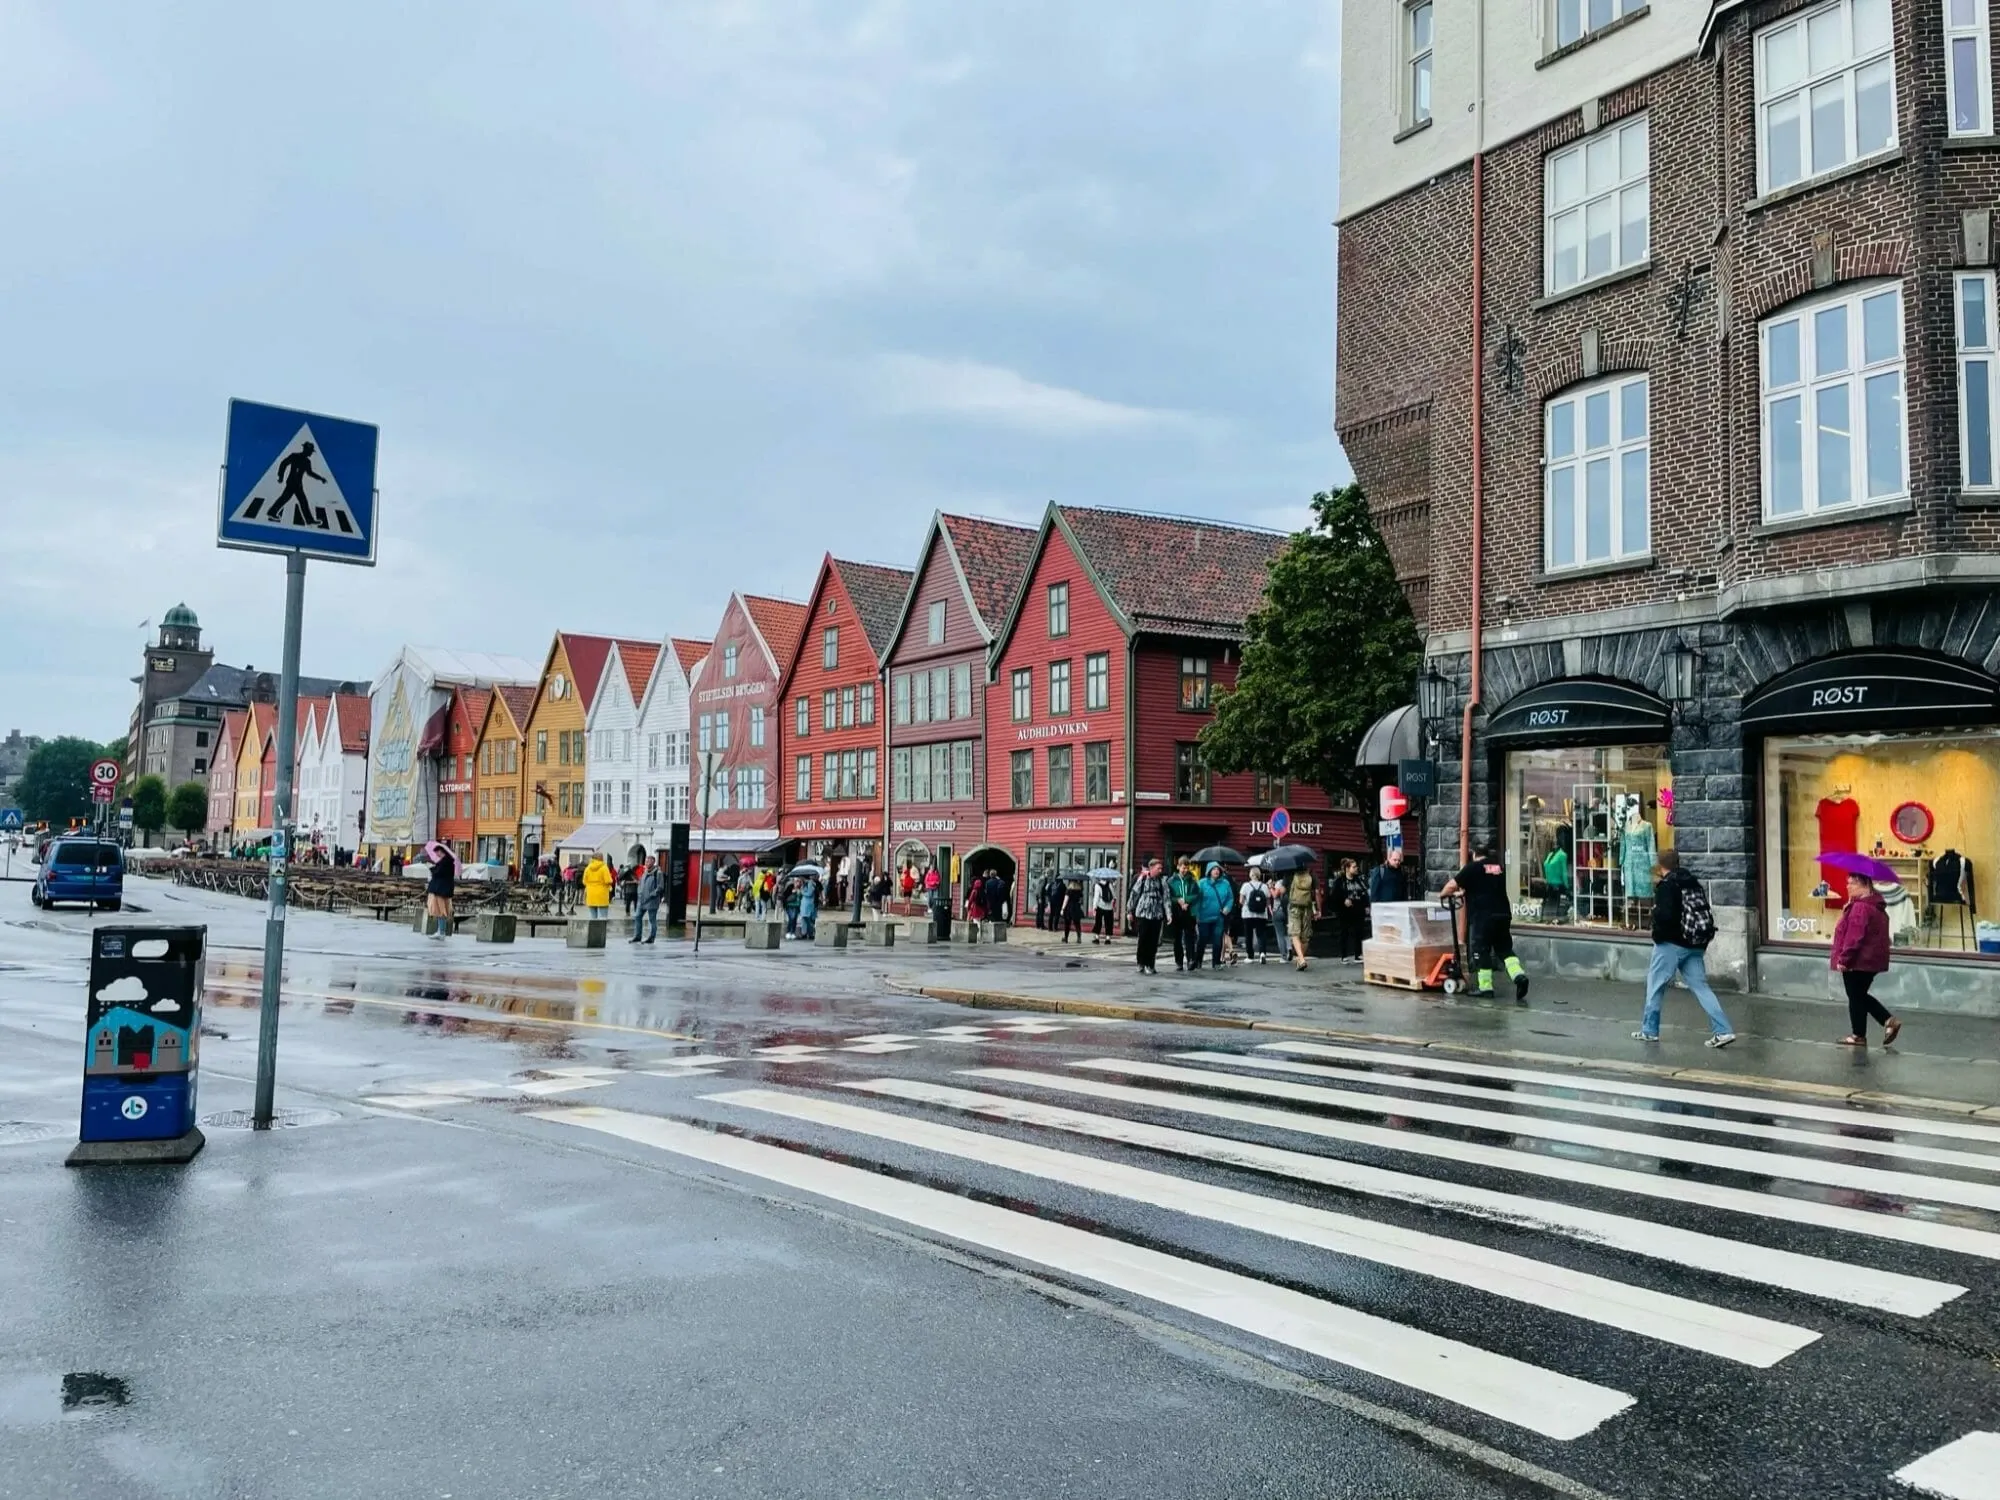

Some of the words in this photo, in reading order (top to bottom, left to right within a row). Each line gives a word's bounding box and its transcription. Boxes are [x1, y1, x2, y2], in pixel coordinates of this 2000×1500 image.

[735, 681, 766, 697] BRYGGEN
[1812, 686, 1868, 706] RØST
[1529, 709, 1569, 726] RØST
[1017, 725, 1058, 741] AUDHILD
[1059, 721, 1089, 735] VIKEN
[97, 766, 116, 779] 30
[795, 819, 817, 831] KNUT
[820, 817, 868, 831] SKURTVEIT
[893, 820, 924, 832] BRYGGEN
[925, 820, 957, 832] HUSFLID
[1027, 818, 1078, 833] JULEHUSET
[1249, 821, 1323, 836] JULUSET
[1512, 903, 1542, 917] RØST
[1776, 917, 1817, 932] RØST
